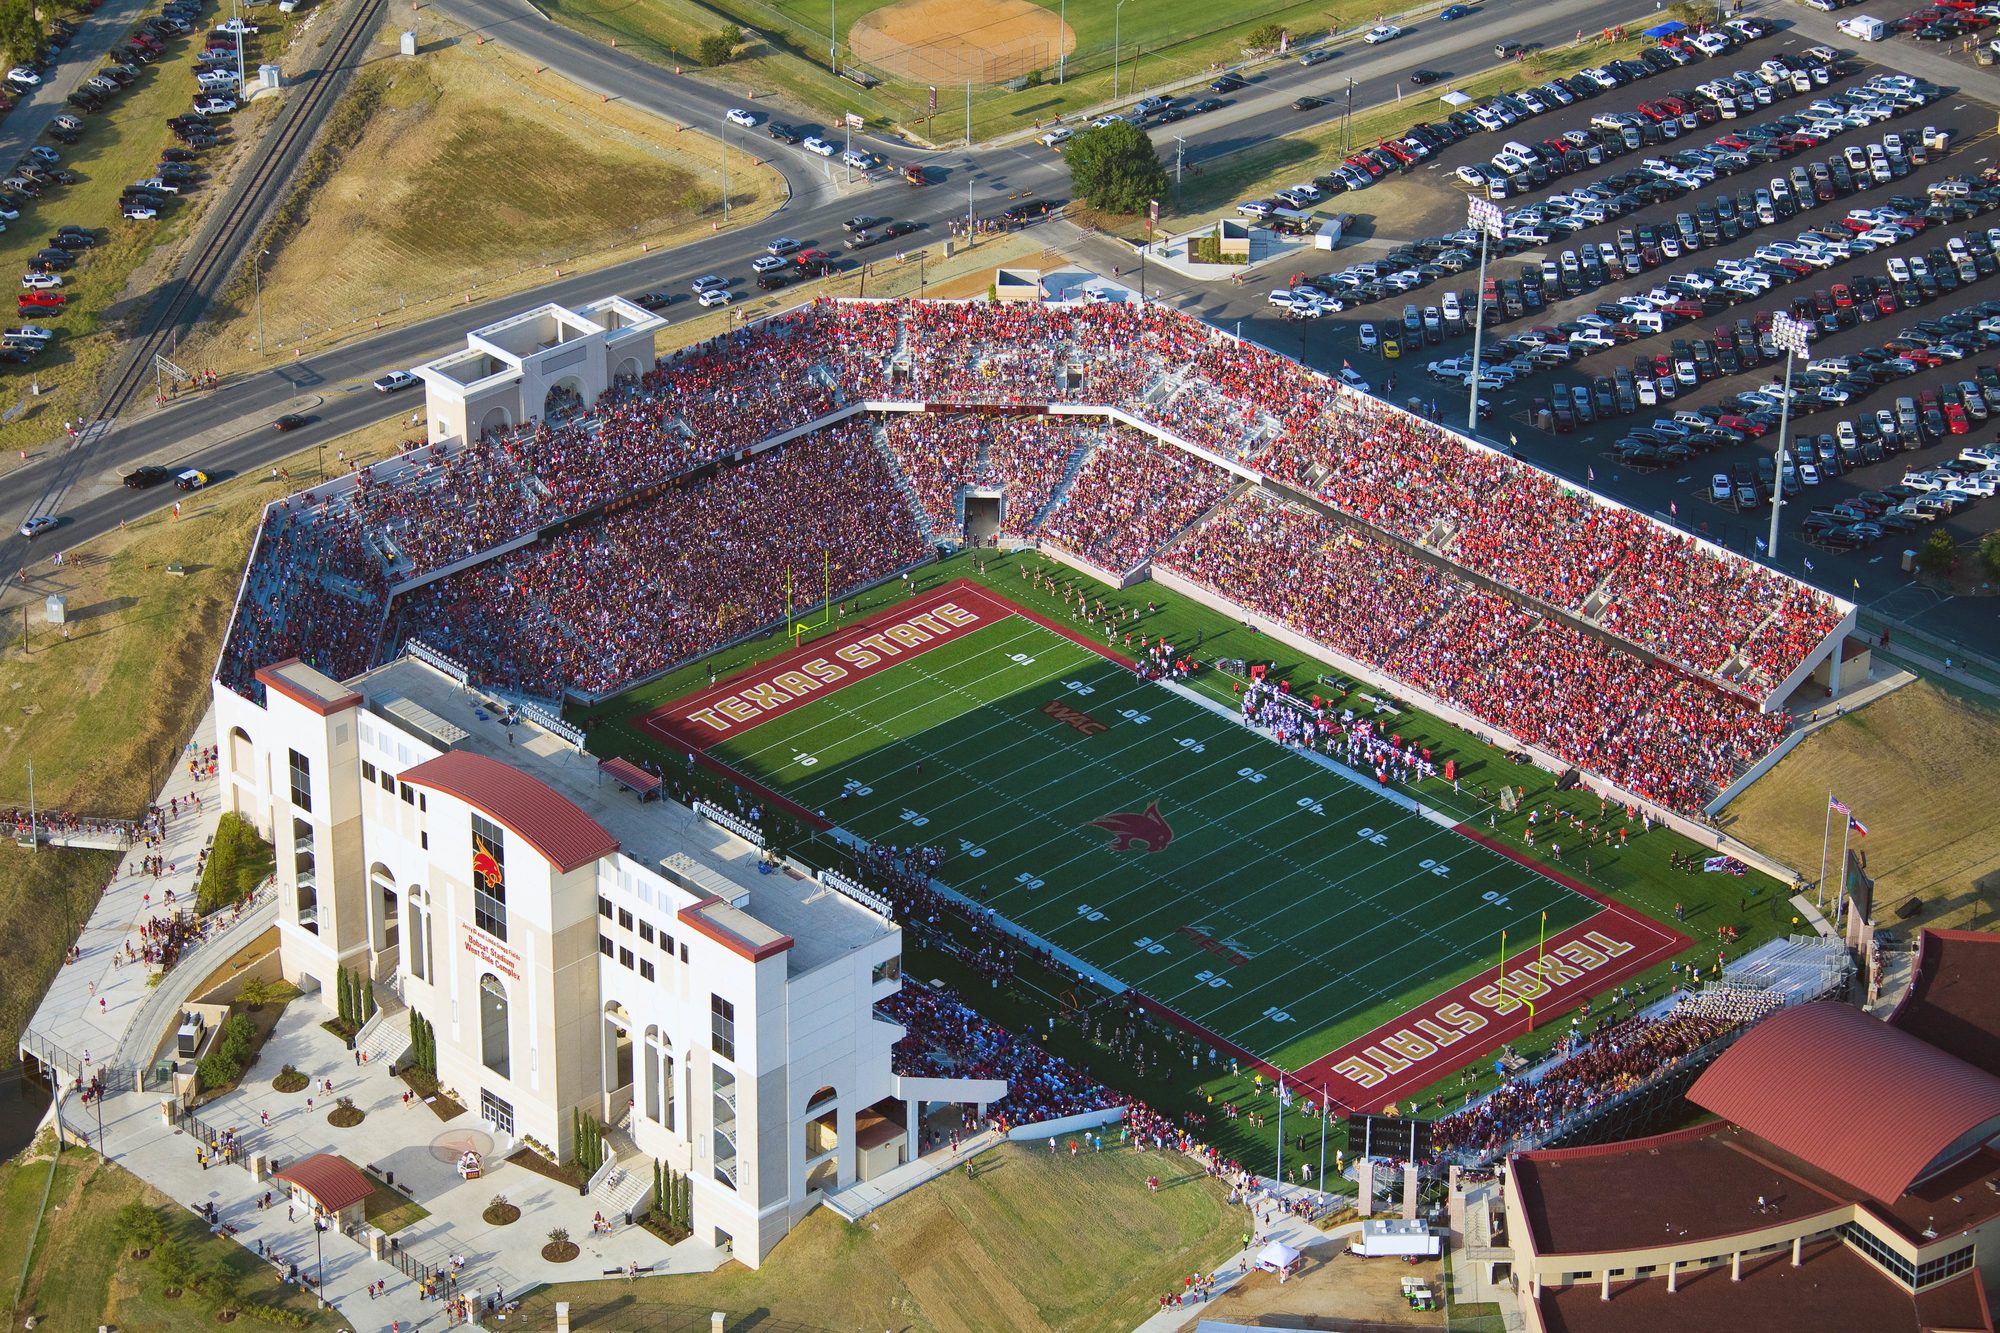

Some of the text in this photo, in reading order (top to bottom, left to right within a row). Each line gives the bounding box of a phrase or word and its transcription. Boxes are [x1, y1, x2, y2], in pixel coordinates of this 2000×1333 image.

[604, 477, 680, 513] TEXAS STATE
[687, 603, 979, 731] TEXAS STATE
[1010, 653, 1036, 666] 10
[1066, 681, 1095, 696] 20
[1040, 700, 1109, 736] WAC
[1121, 709, 1151, 725] 30
[1179, 738, 1206, 754] 40
[794, 752, 818, 767] 10
[1237, 768, 1268, 784] 50
[844, 779, 873, 797] 20
[1297, 798, 1324, 815] 40
[900, 810, 930, 827] 30
[1357, 828, 1388, 844] 30
[959, 841, 987, 858] 40
[1418, 859, 1449, 876] 20
[1014, 872, 1046, 890] 50
[1481, 891, 1507, 906] 10
[1076, 904, 1105, 922] 40
[468, 935, 515, 969] Bobcat Stadium
[1133, 937, 1165, 955] 30
[1174, 926, 1250, 967] FIELD
[464, 941, 521, 982] West Side Complex
[1194, 970, 1226, 989] 20
[1262, 1007, 1289, 1024] 10
[1331, 930, 1636, 1089] TEXAS STATE
